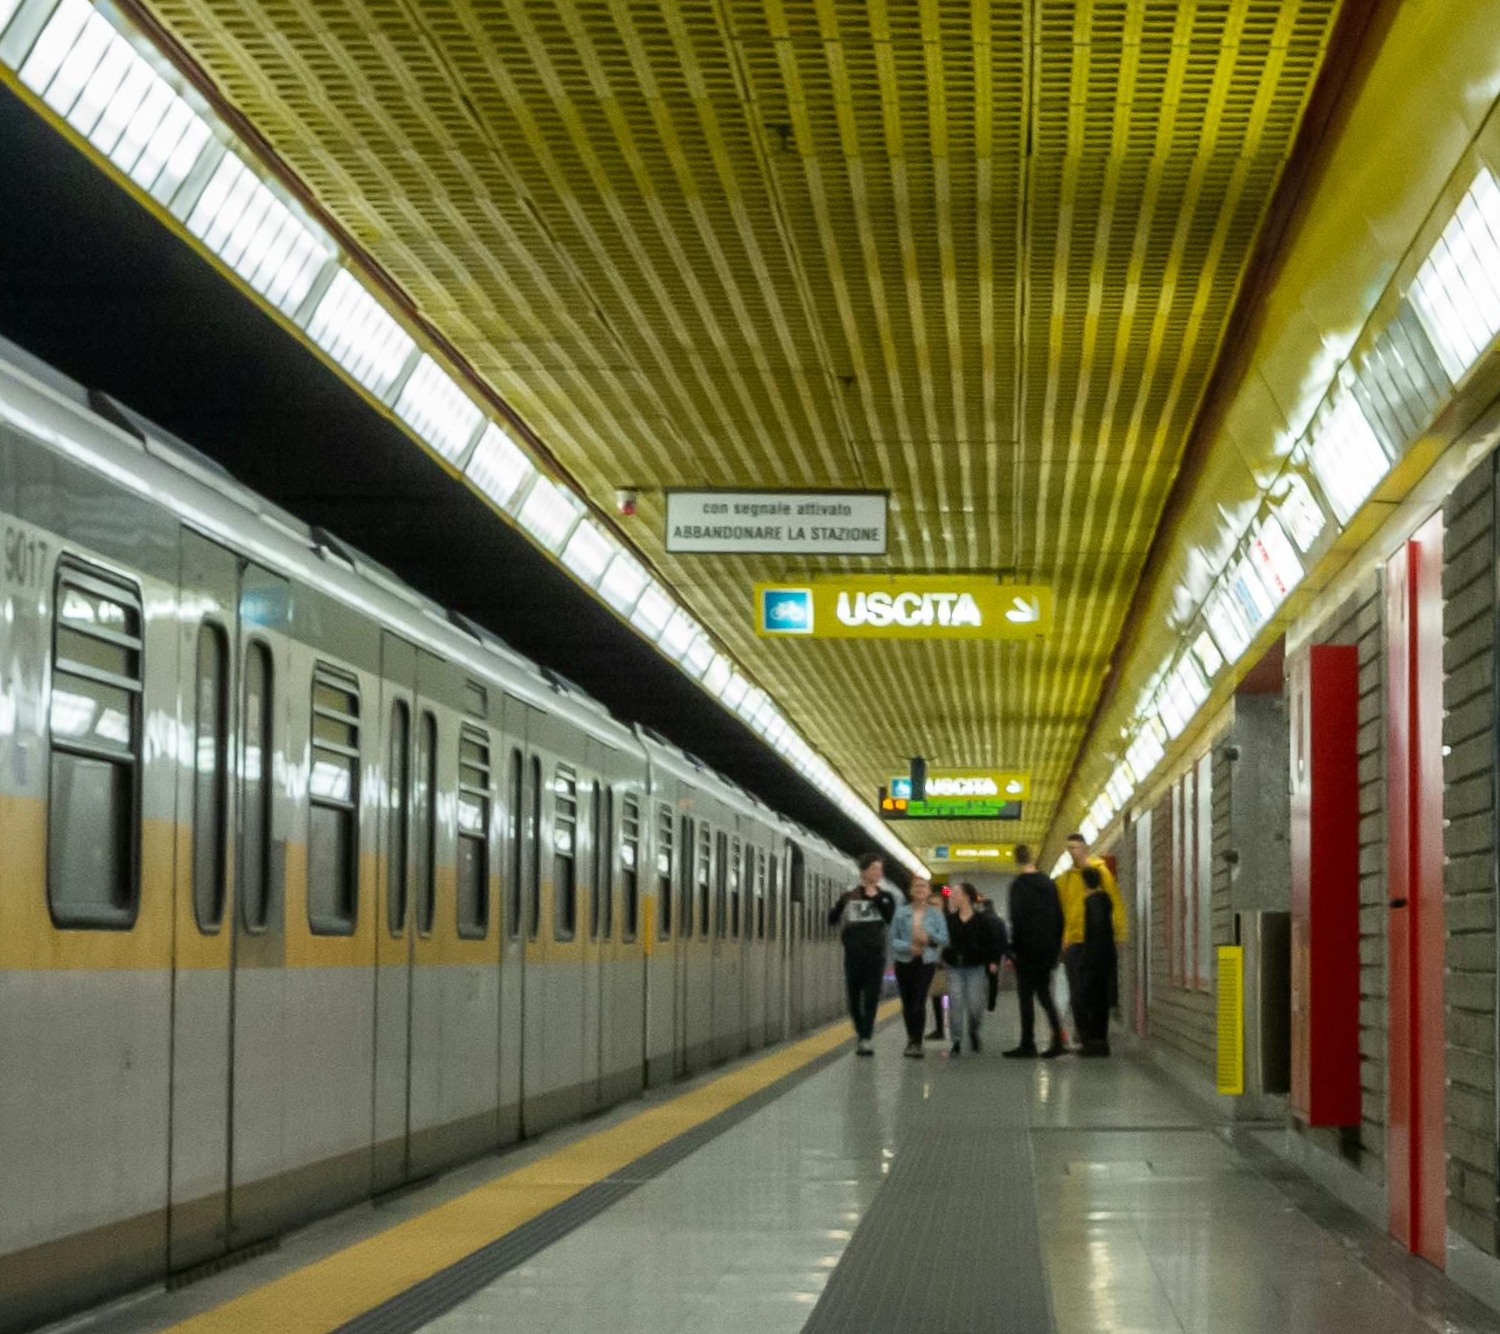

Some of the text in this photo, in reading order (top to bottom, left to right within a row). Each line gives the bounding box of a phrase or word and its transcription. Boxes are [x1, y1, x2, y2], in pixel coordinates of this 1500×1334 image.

[703, 501, 852, 517] con segnale attivato
[673, 525, 879, 542] ABBANDONARE LA STAZIONE
[836, 590, 982, 627] USCITA
[925, 777, 998, 796] USCITA
